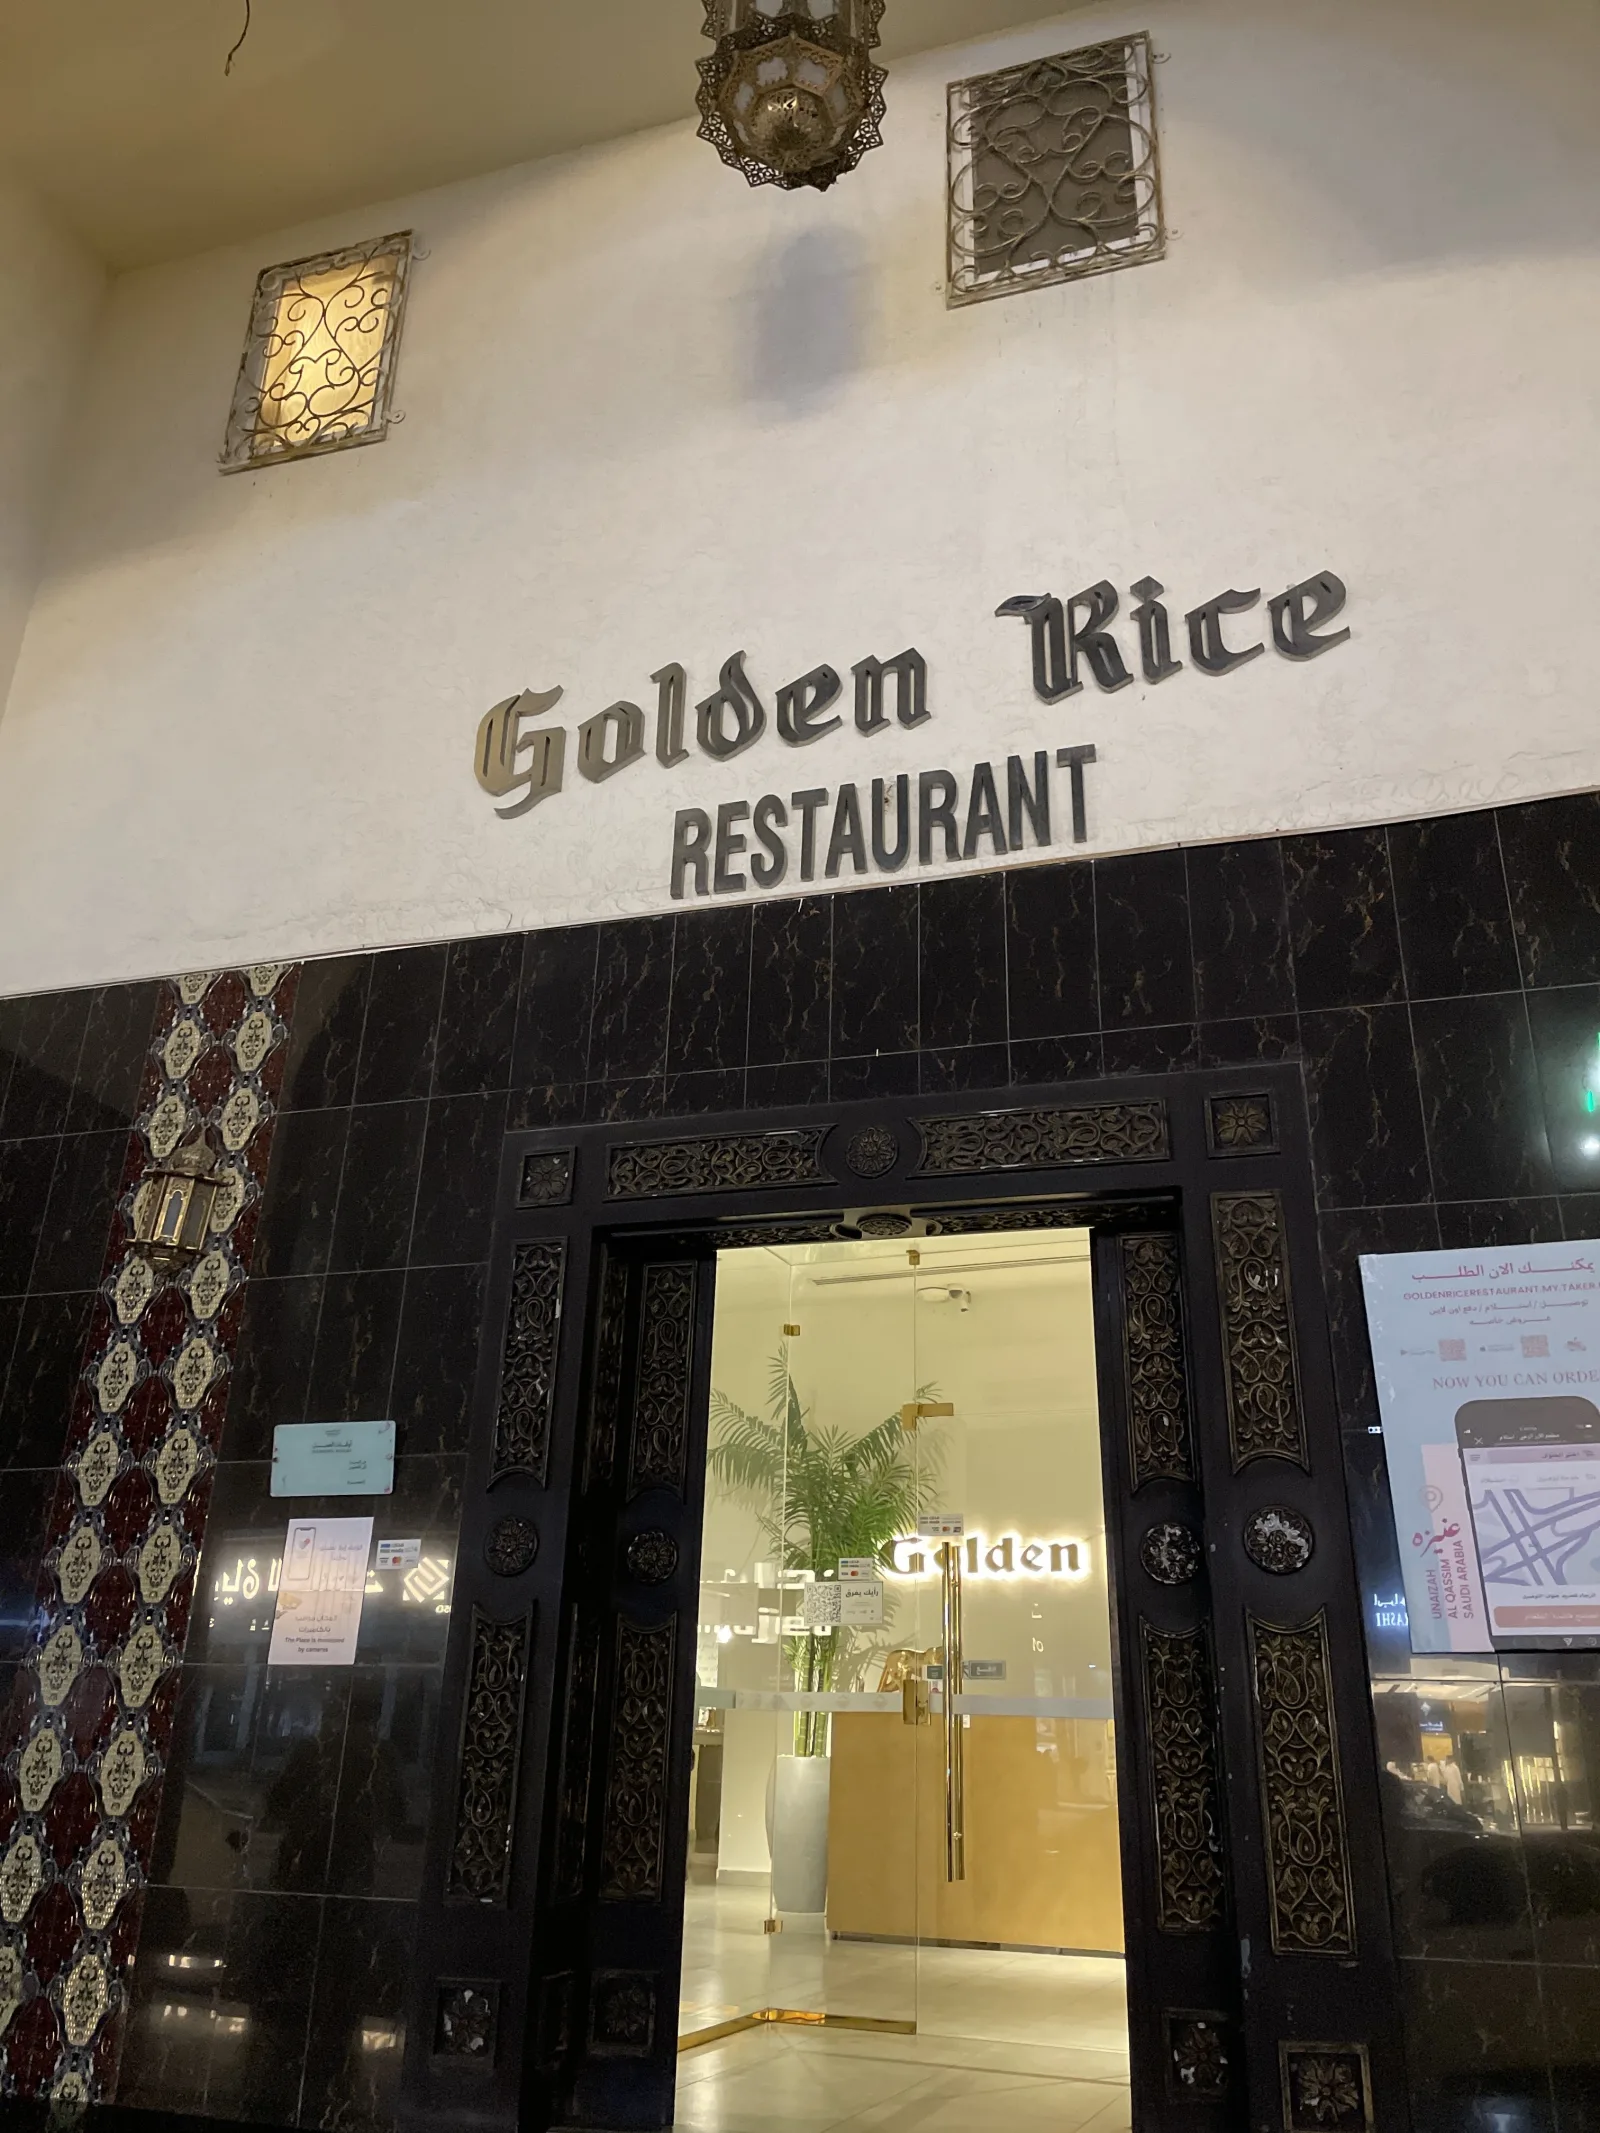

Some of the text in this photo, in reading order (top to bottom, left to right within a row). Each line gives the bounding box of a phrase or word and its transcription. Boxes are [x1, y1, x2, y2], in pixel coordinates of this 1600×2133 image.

[473, 569, 1351, 820] Golden Rice
[669, 743, 1097, 899] RESTAURANT
[1411, 1257, 1596, 1284] يمكنك الان الطلب
[1432, 1368, 1600, 1390] NOW YOU CAN ORDE
[863, 1586, 879, 1598] رأيك
[1425, 1569, 1443, 1620] UNAIZAH
[1440, 1559, 1459, 1619] AL QASSIM
[1453, 1540, 1474, 1619] SAUDI ARABIA
